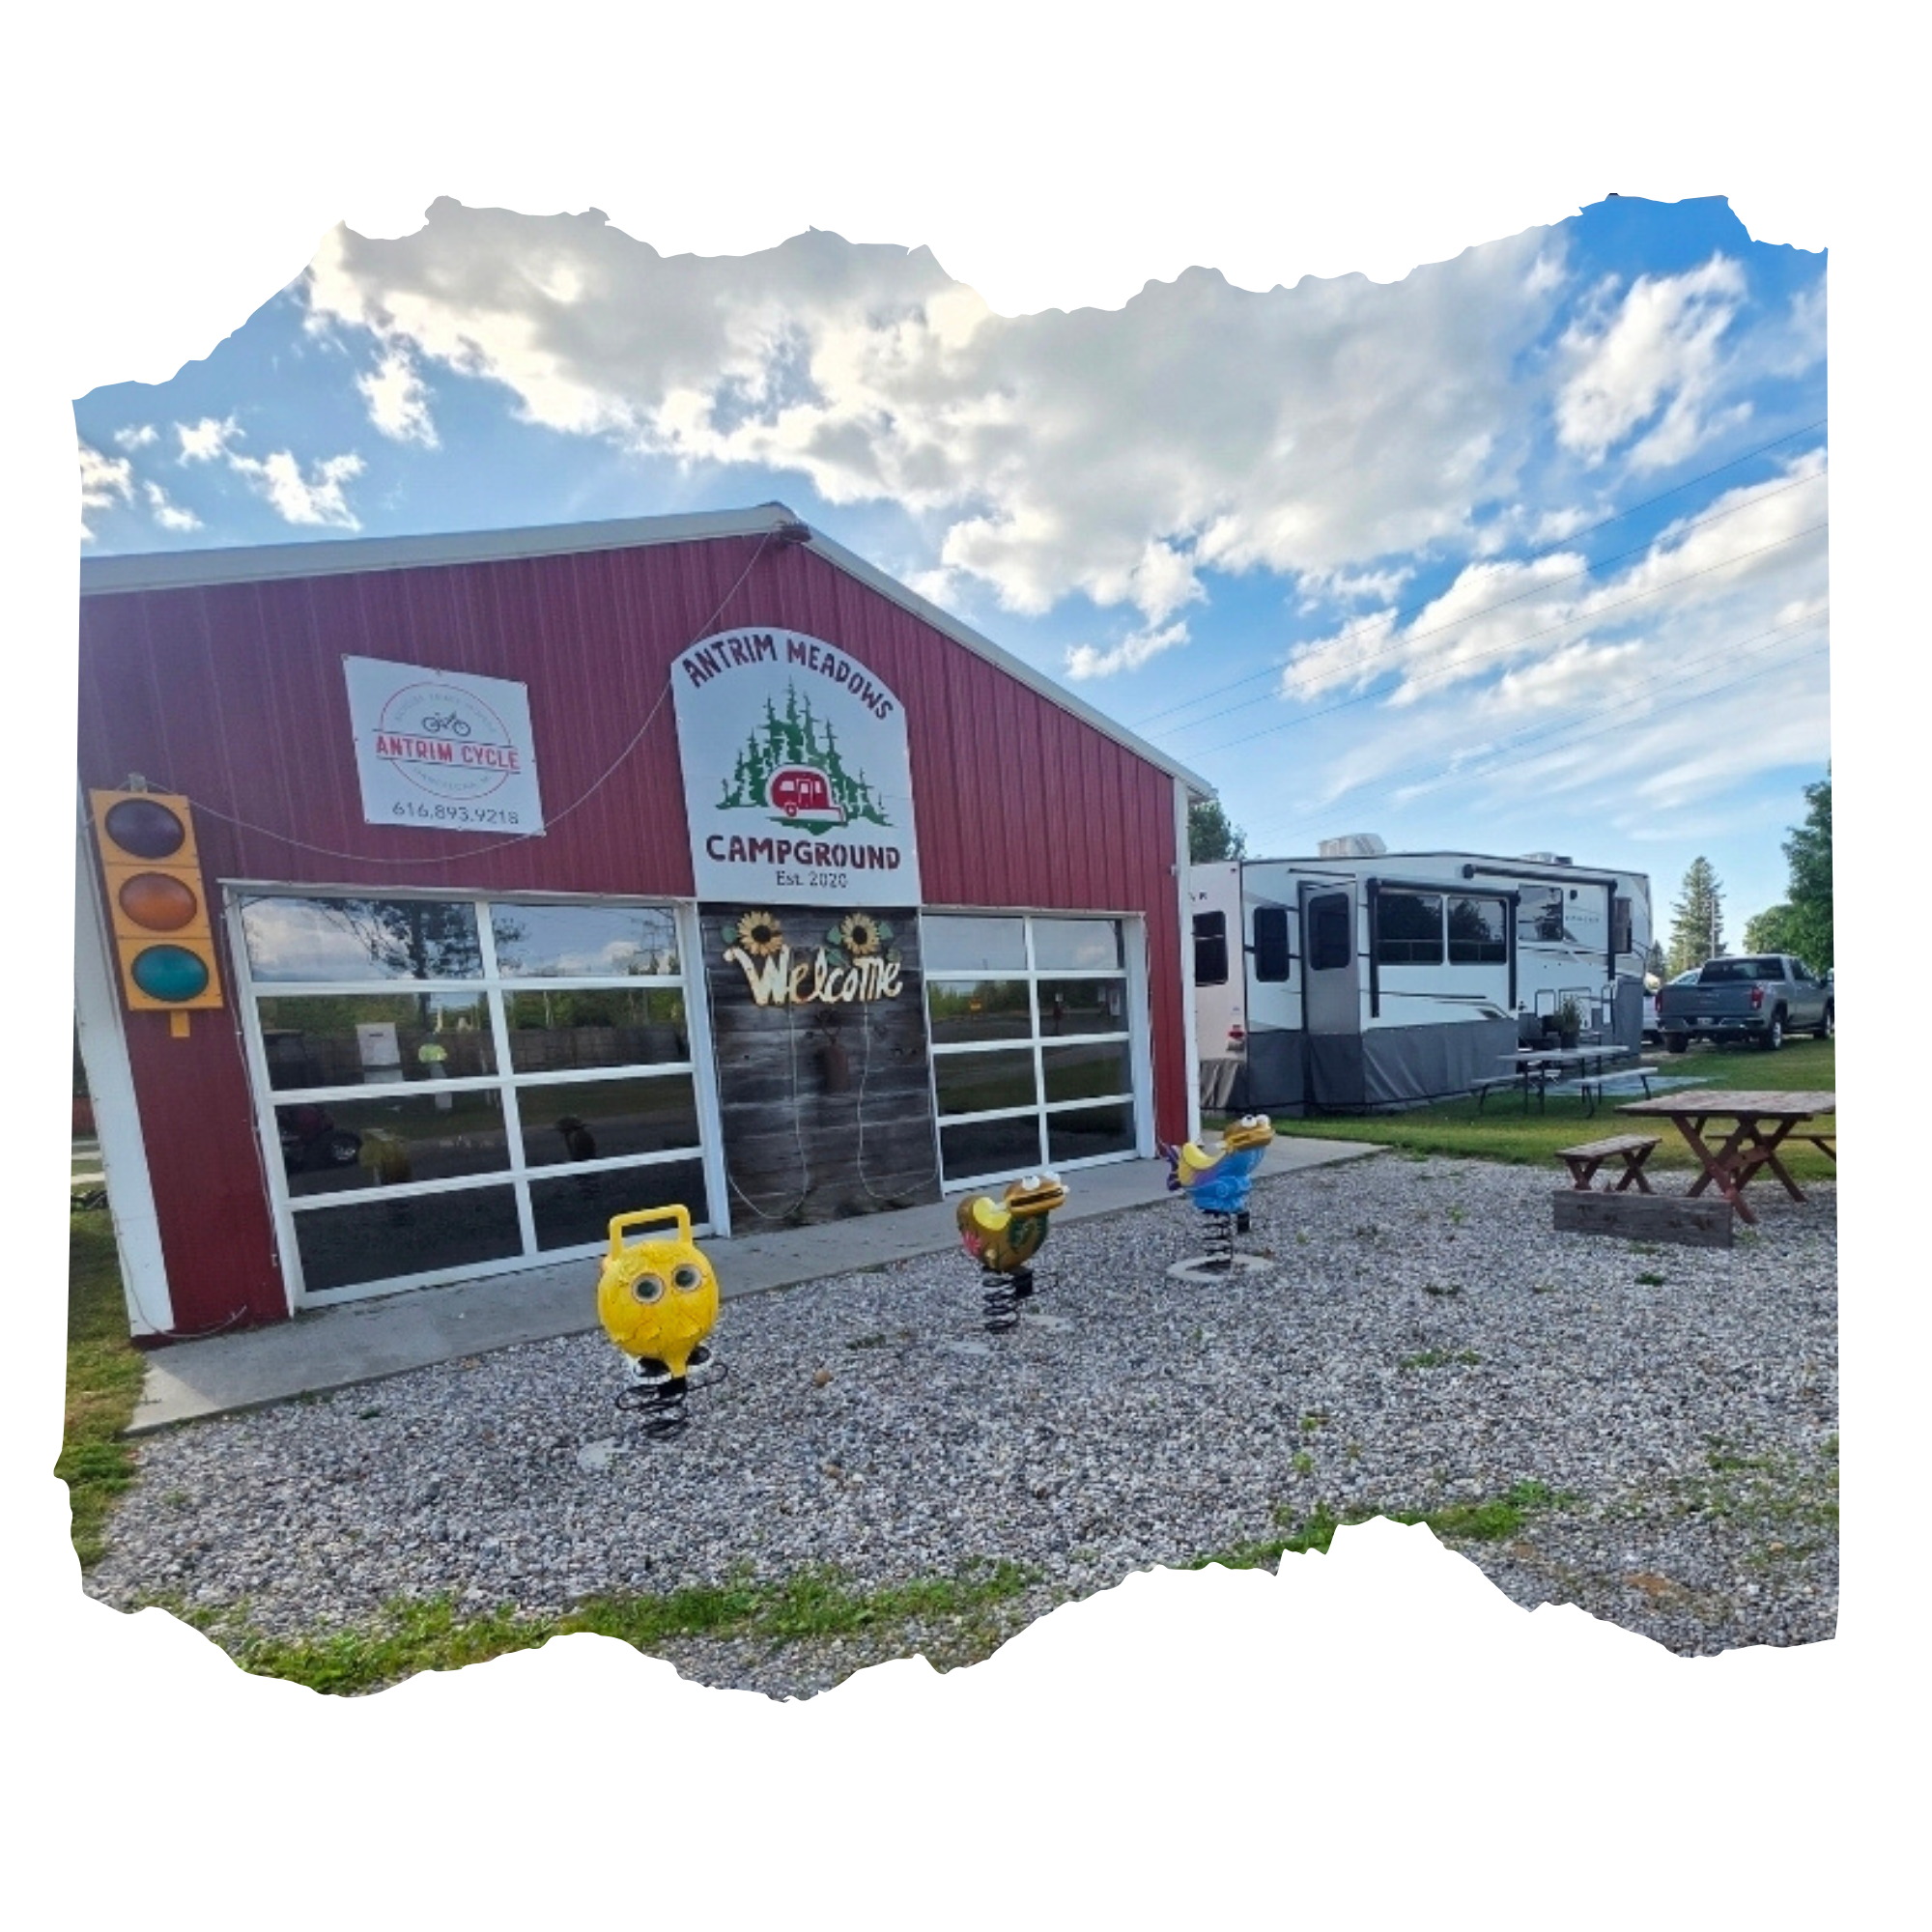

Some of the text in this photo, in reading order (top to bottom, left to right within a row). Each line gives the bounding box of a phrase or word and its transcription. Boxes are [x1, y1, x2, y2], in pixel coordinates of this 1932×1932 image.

[682, 634, 894, 720] ANTRIM MEADOWS
[376, 735, 521, 770] ANTRIM CYCLE
[392, 801, 520, 826] 616.893.9218
[706, 835, 901, 871] CAMPGROUND
[809, 871, 849, 889] 2020
[723, 944, 904, 1008] Welcome
